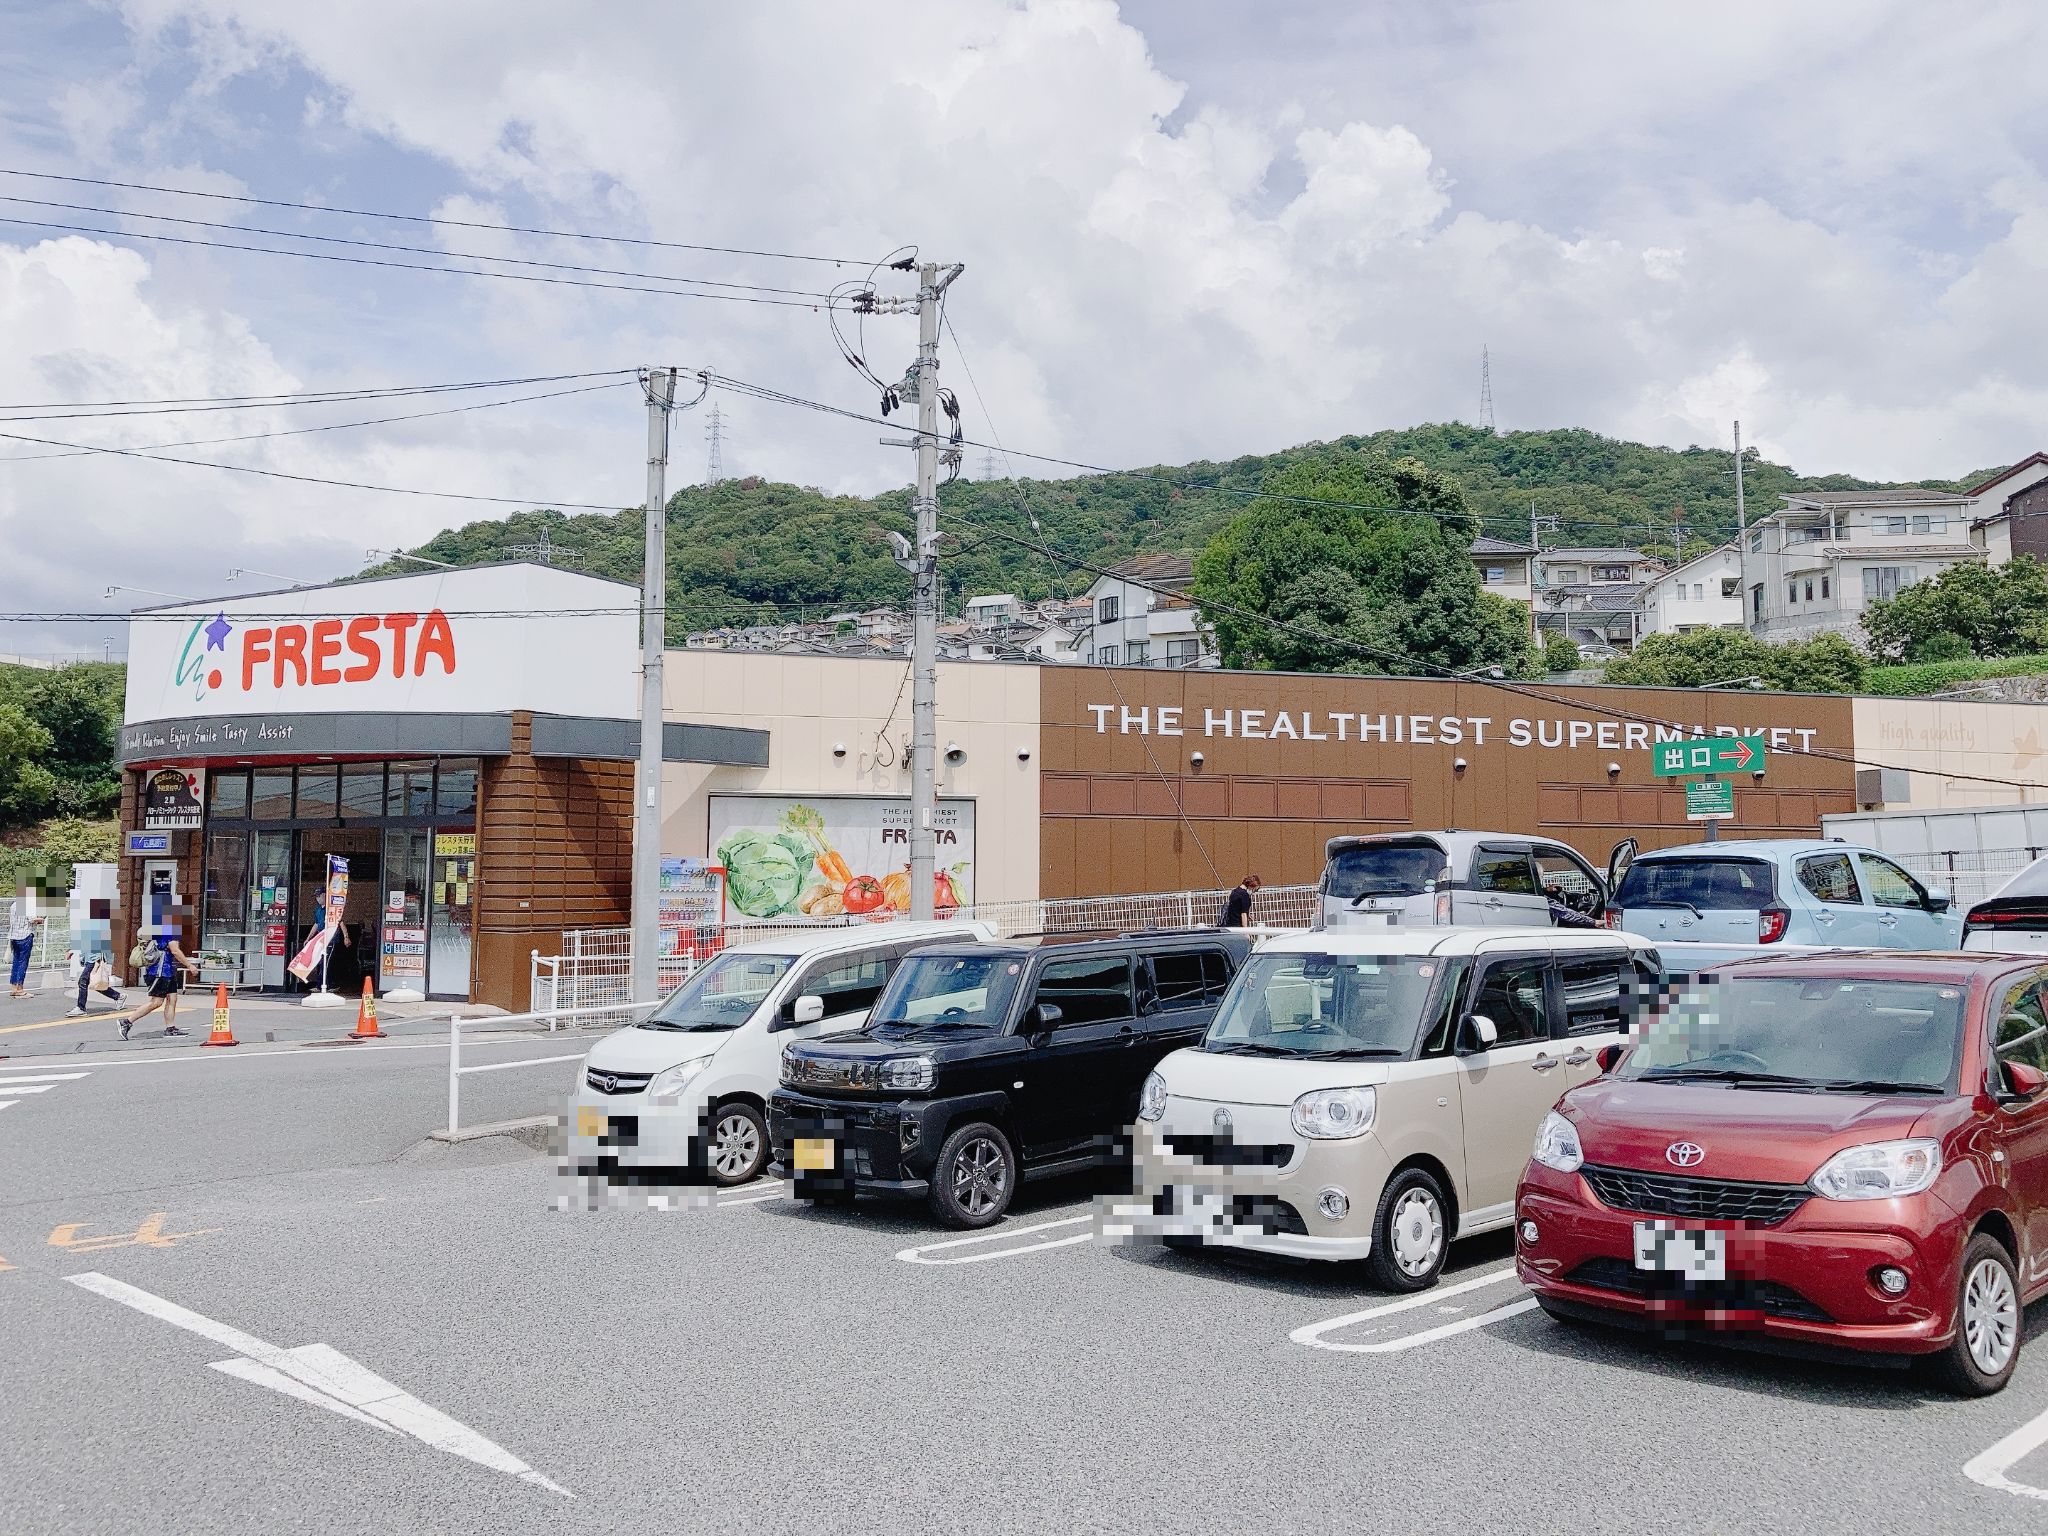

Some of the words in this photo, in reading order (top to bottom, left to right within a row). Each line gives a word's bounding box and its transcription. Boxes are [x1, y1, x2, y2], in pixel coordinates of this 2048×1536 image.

[242, 608, 456, 692] FRESTA
[169, 727, 191, 750] Enjoy
[194, 724, 218, 744] Smile
[222, 723, 248, 745] Tasty
[257, 722, 293, 740] Assist
[1087, 703, 1184, 737] THE
[1204, 708, 1492, 746] HEALTHIEST
[1881, 721, 1914, 749] High
[1920, 722, 1975, 751] quality
[1664, 747, 1711, 770] 出口
[882, 828, 957, 845] FRTA
